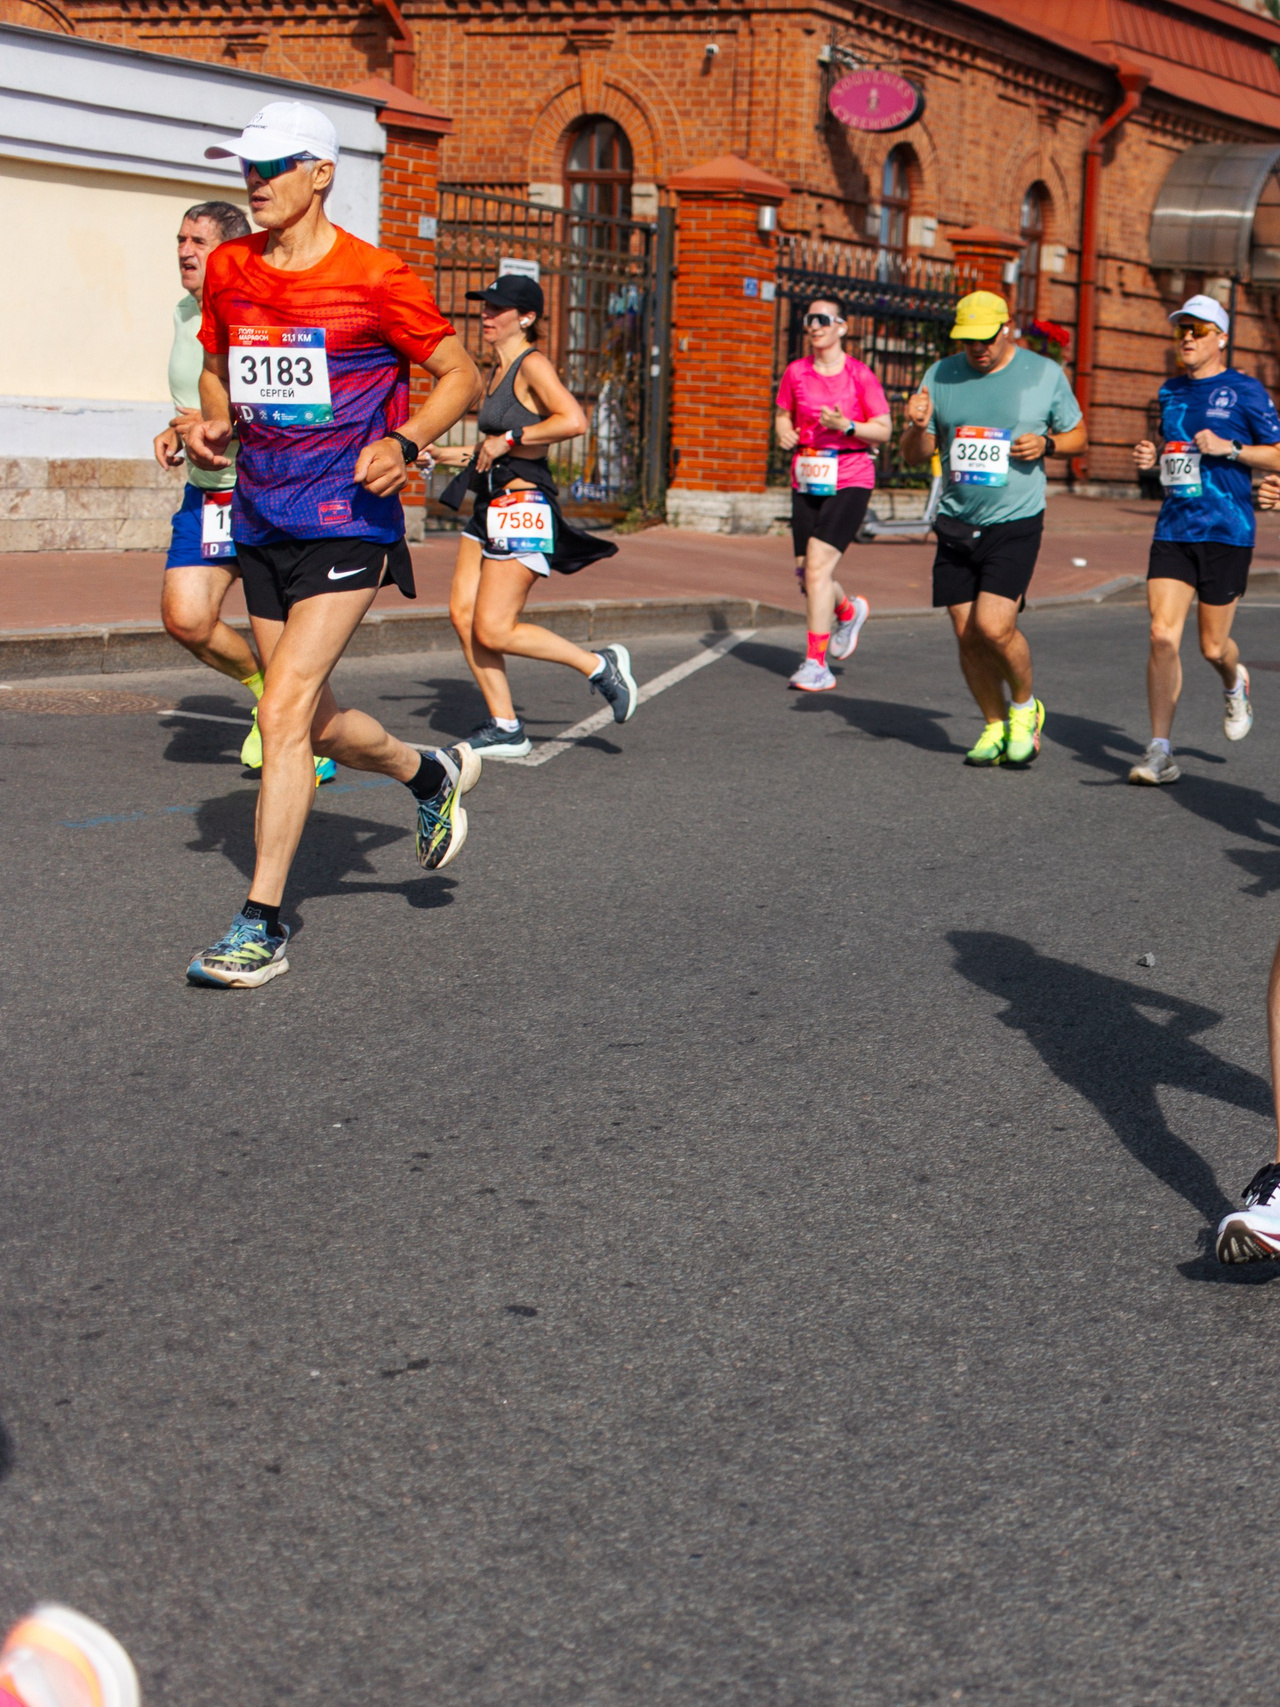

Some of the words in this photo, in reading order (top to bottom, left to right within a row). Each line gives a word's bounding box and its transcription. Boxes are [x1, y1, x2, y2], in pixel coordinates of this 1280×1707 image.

[281, 333, 296, 343] 21,1
[240, 355, 314, 386] 3183
[260, 388, 295, 398] СЕРГЕЙ
[241, 405, 254, 421] D
[957, 443, 1001, 462] 3268
[1165, 458, 1193, 476] 1076
[216, 510, 232, 530] 1
[497, 512, 544, 530] 7586
[210, 543, 219, 555] D
